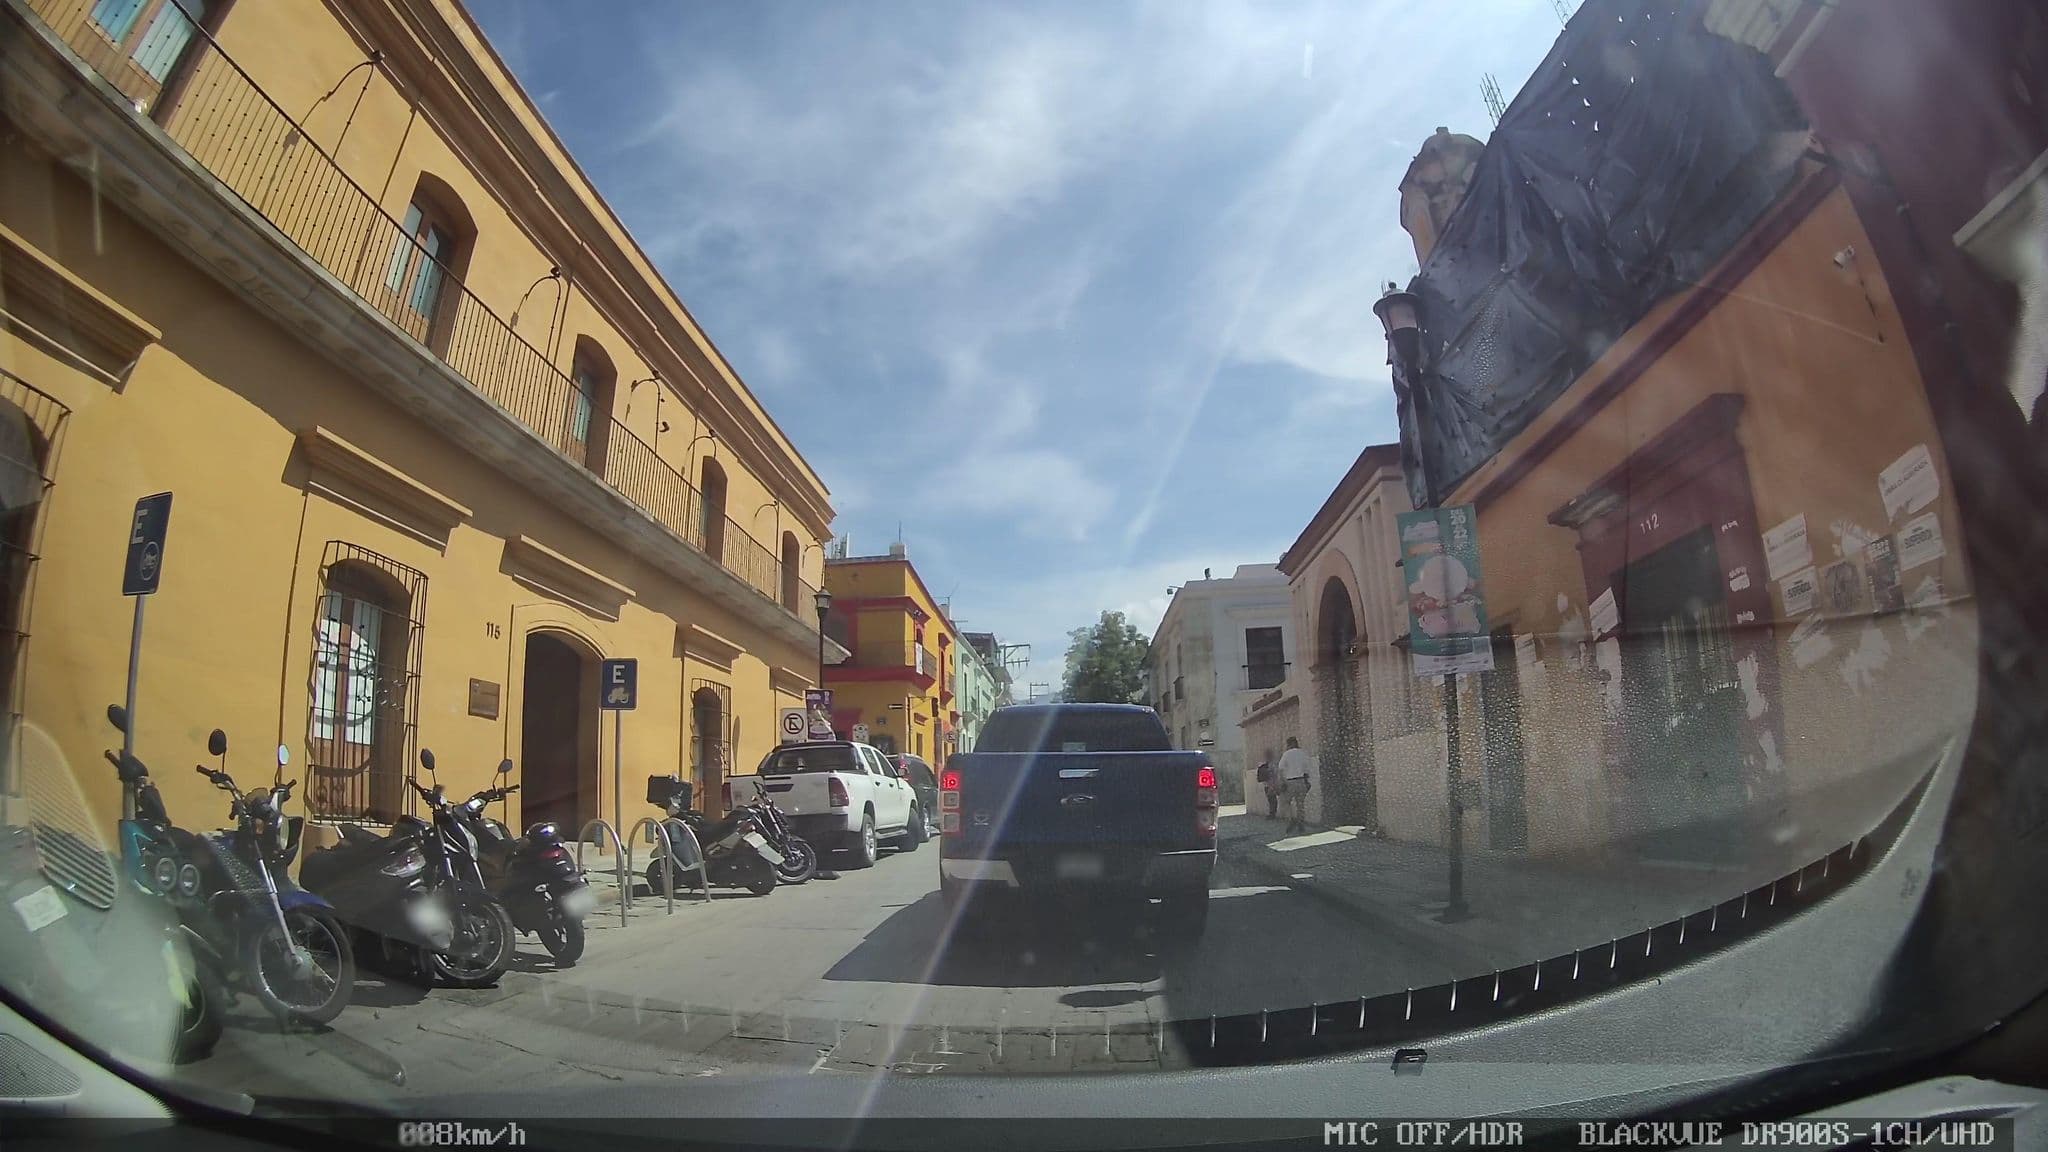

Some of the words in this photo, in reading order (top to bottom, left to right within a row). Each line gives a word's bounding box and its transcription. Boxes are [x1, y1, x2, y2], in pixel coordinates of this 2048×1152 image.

[132, 509, 149, 544] E
[1640, 513, 1660, 535] 112
[612, 664, 626, 684] E
